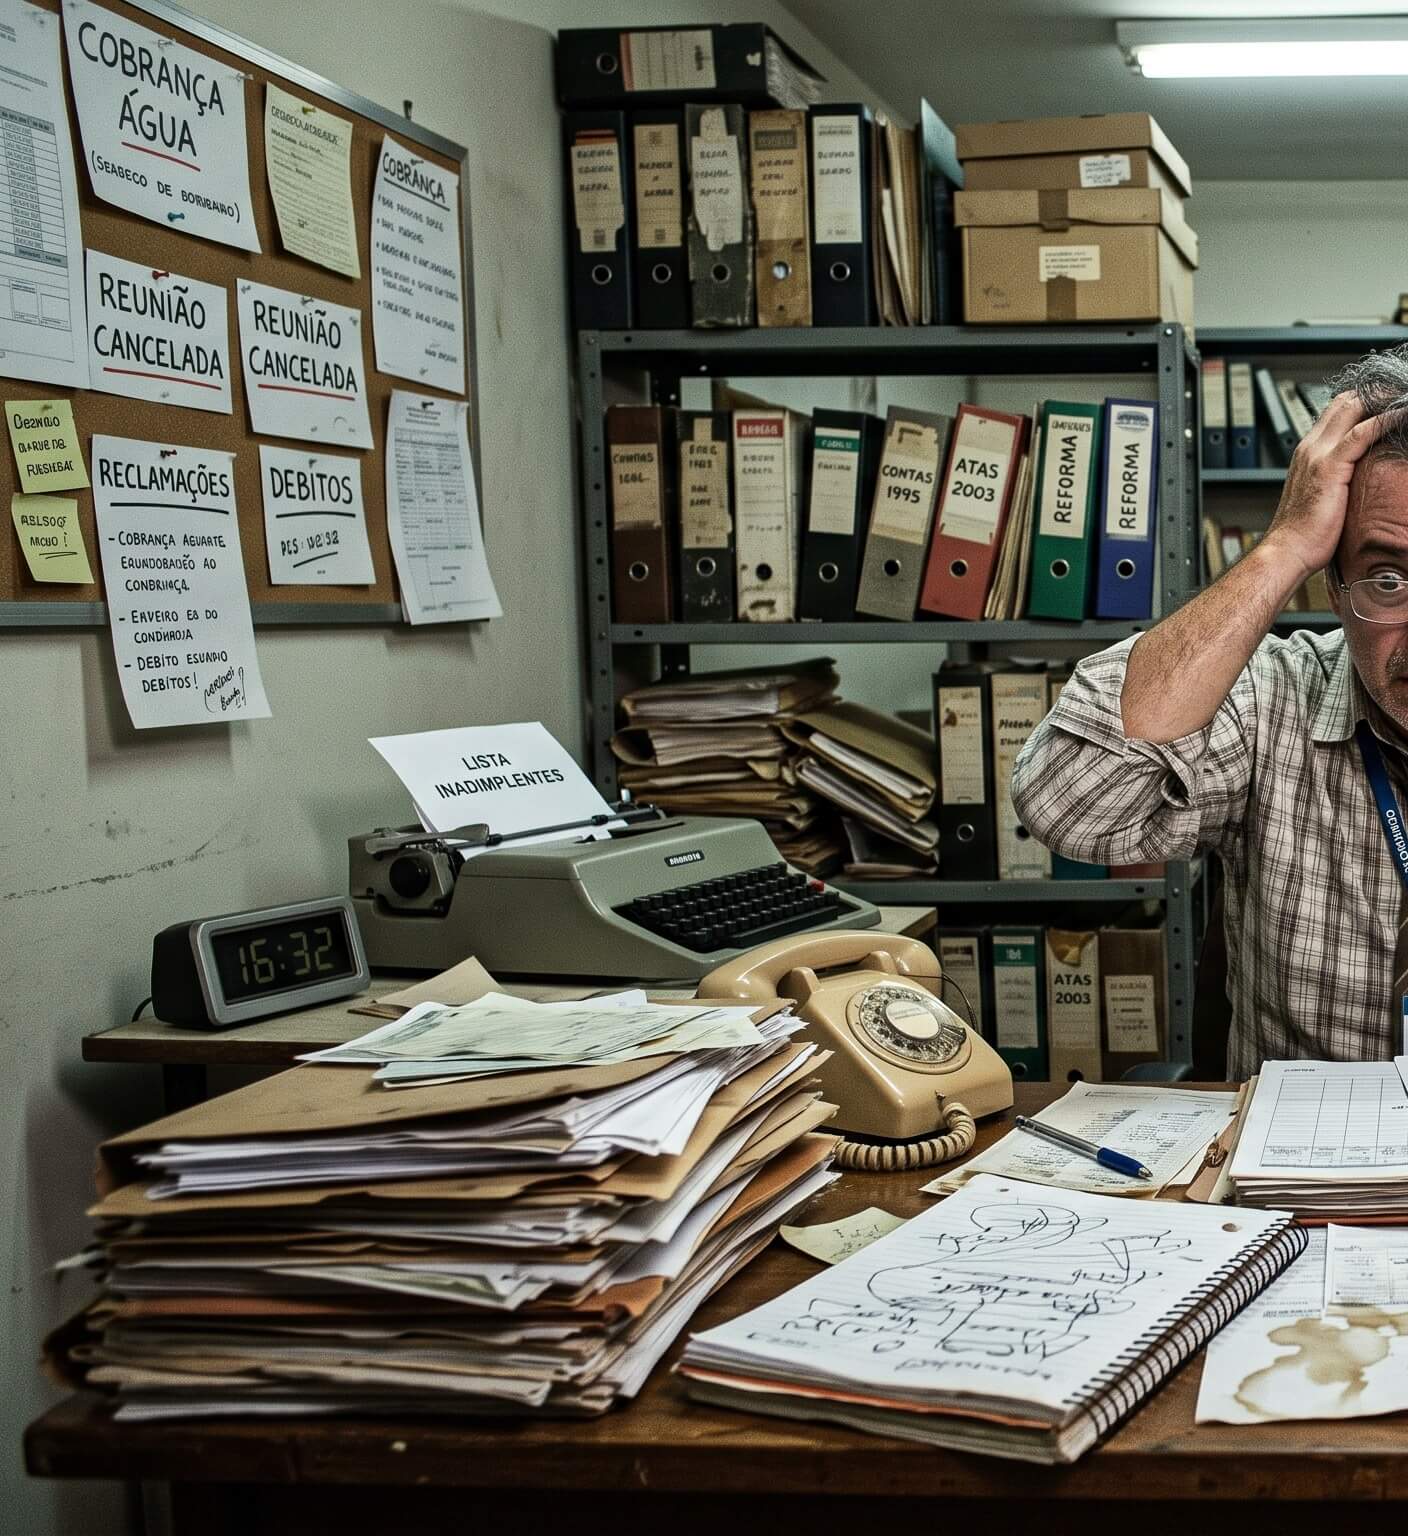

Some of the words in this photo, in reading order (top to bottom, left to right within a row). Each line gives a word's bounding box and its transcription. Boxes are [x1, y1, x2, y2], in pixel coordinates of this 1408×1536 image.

[78, 21, 225, 116] COBRANÇA
[119, 88, 197, 157] ÁGUA
[157, 181, 173, 197] DE
[382, 152, 447, 204] COBRANÇA
[99, 272, 206, 330] REUNIÃO
[253, 299, 342, 349] REUNIÃO
[94, 324, 224, 379] CANCELADA
[249, 345, 358, 393] CANCELADA
[98, 458, 230, 503] RECLAMAÇÕES
[270, 467, 353, 504] DEBITOS
[882, 464, 933, 484] CONTAS
[955, 459, 999, 479] ATAS
[1054, 434, 1078, 524] REFORMA
[1119, 442, 1140, 529] REFORMA
[886, 486, 920, 504] 1995
[952, 482, 995, 502] 2003
[118, 530, 176, 550] COBRANÇA
[203, 557, 217, 569] AO
[205, 609, 218, 620] DO
[461, 753, 511, 771] LISTA
[435, 769, 565, 799] INADIMPLENTES
[239, 927, 334, 985] 16:32
[1054, 973, 1092, 985] ATAS
[1055, 992, 1091, 1005] 2003
